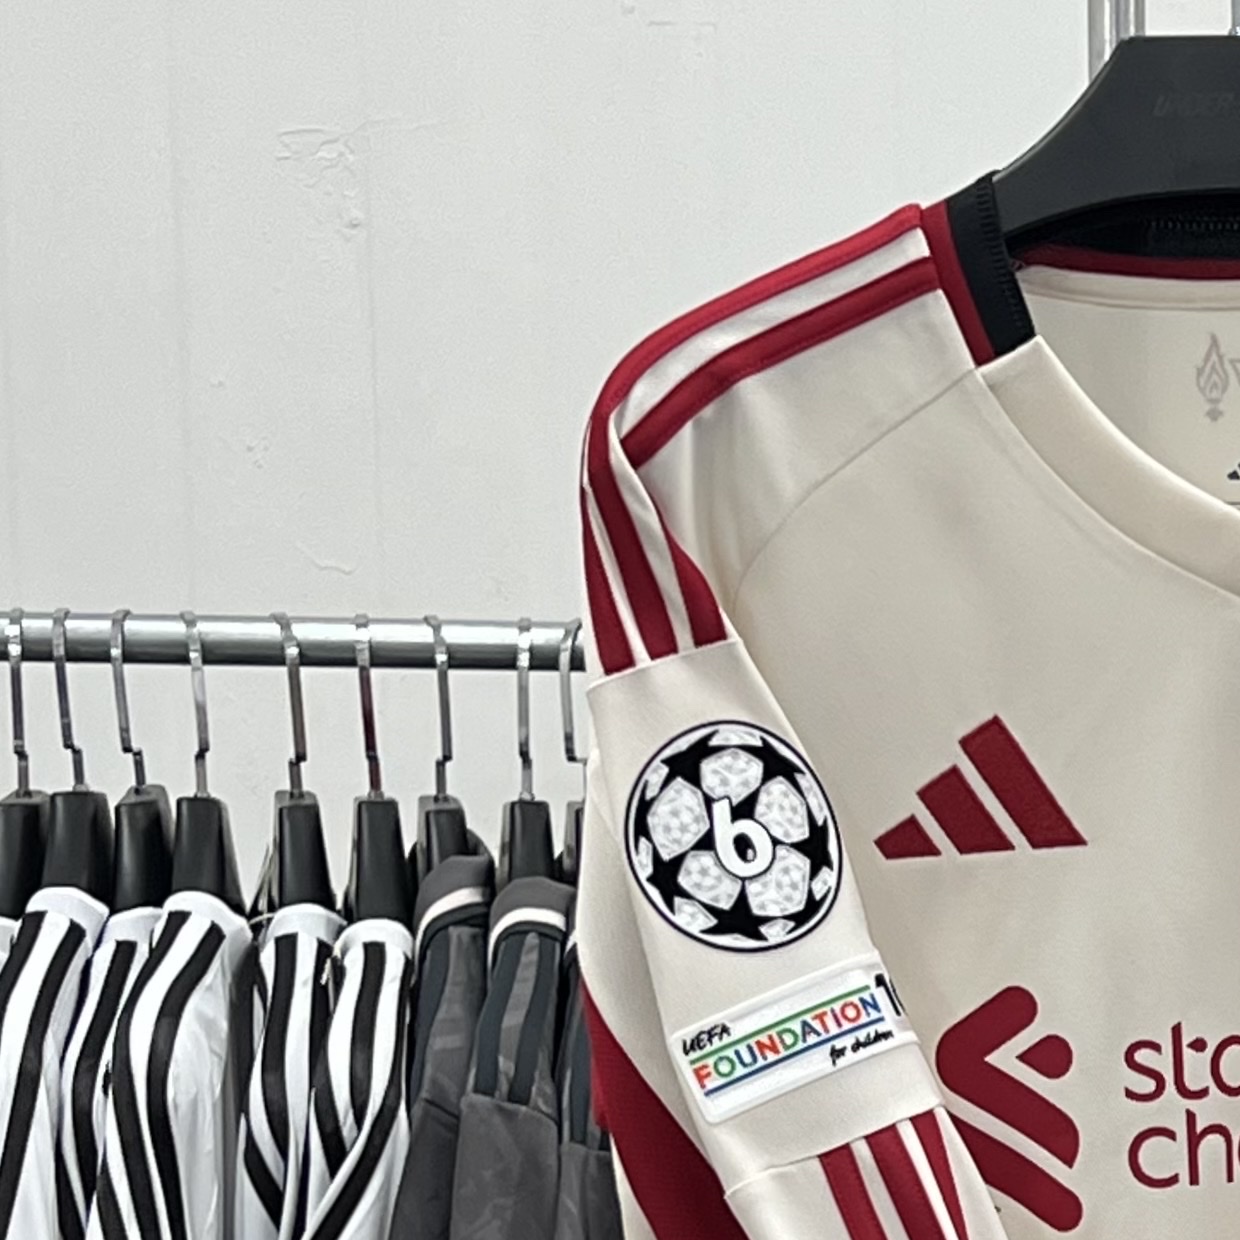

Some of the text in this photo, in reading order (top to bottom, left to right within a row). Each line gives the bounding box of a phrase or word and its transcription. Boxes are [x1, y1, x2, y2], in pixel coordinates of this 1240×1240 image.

[711, 797, 775, 878] 6
[682, 1022, 732, 1057] UEFA
[692, 993, 882, 1090] FOUNDATION
[828, 1028, 894, 1067] for children
